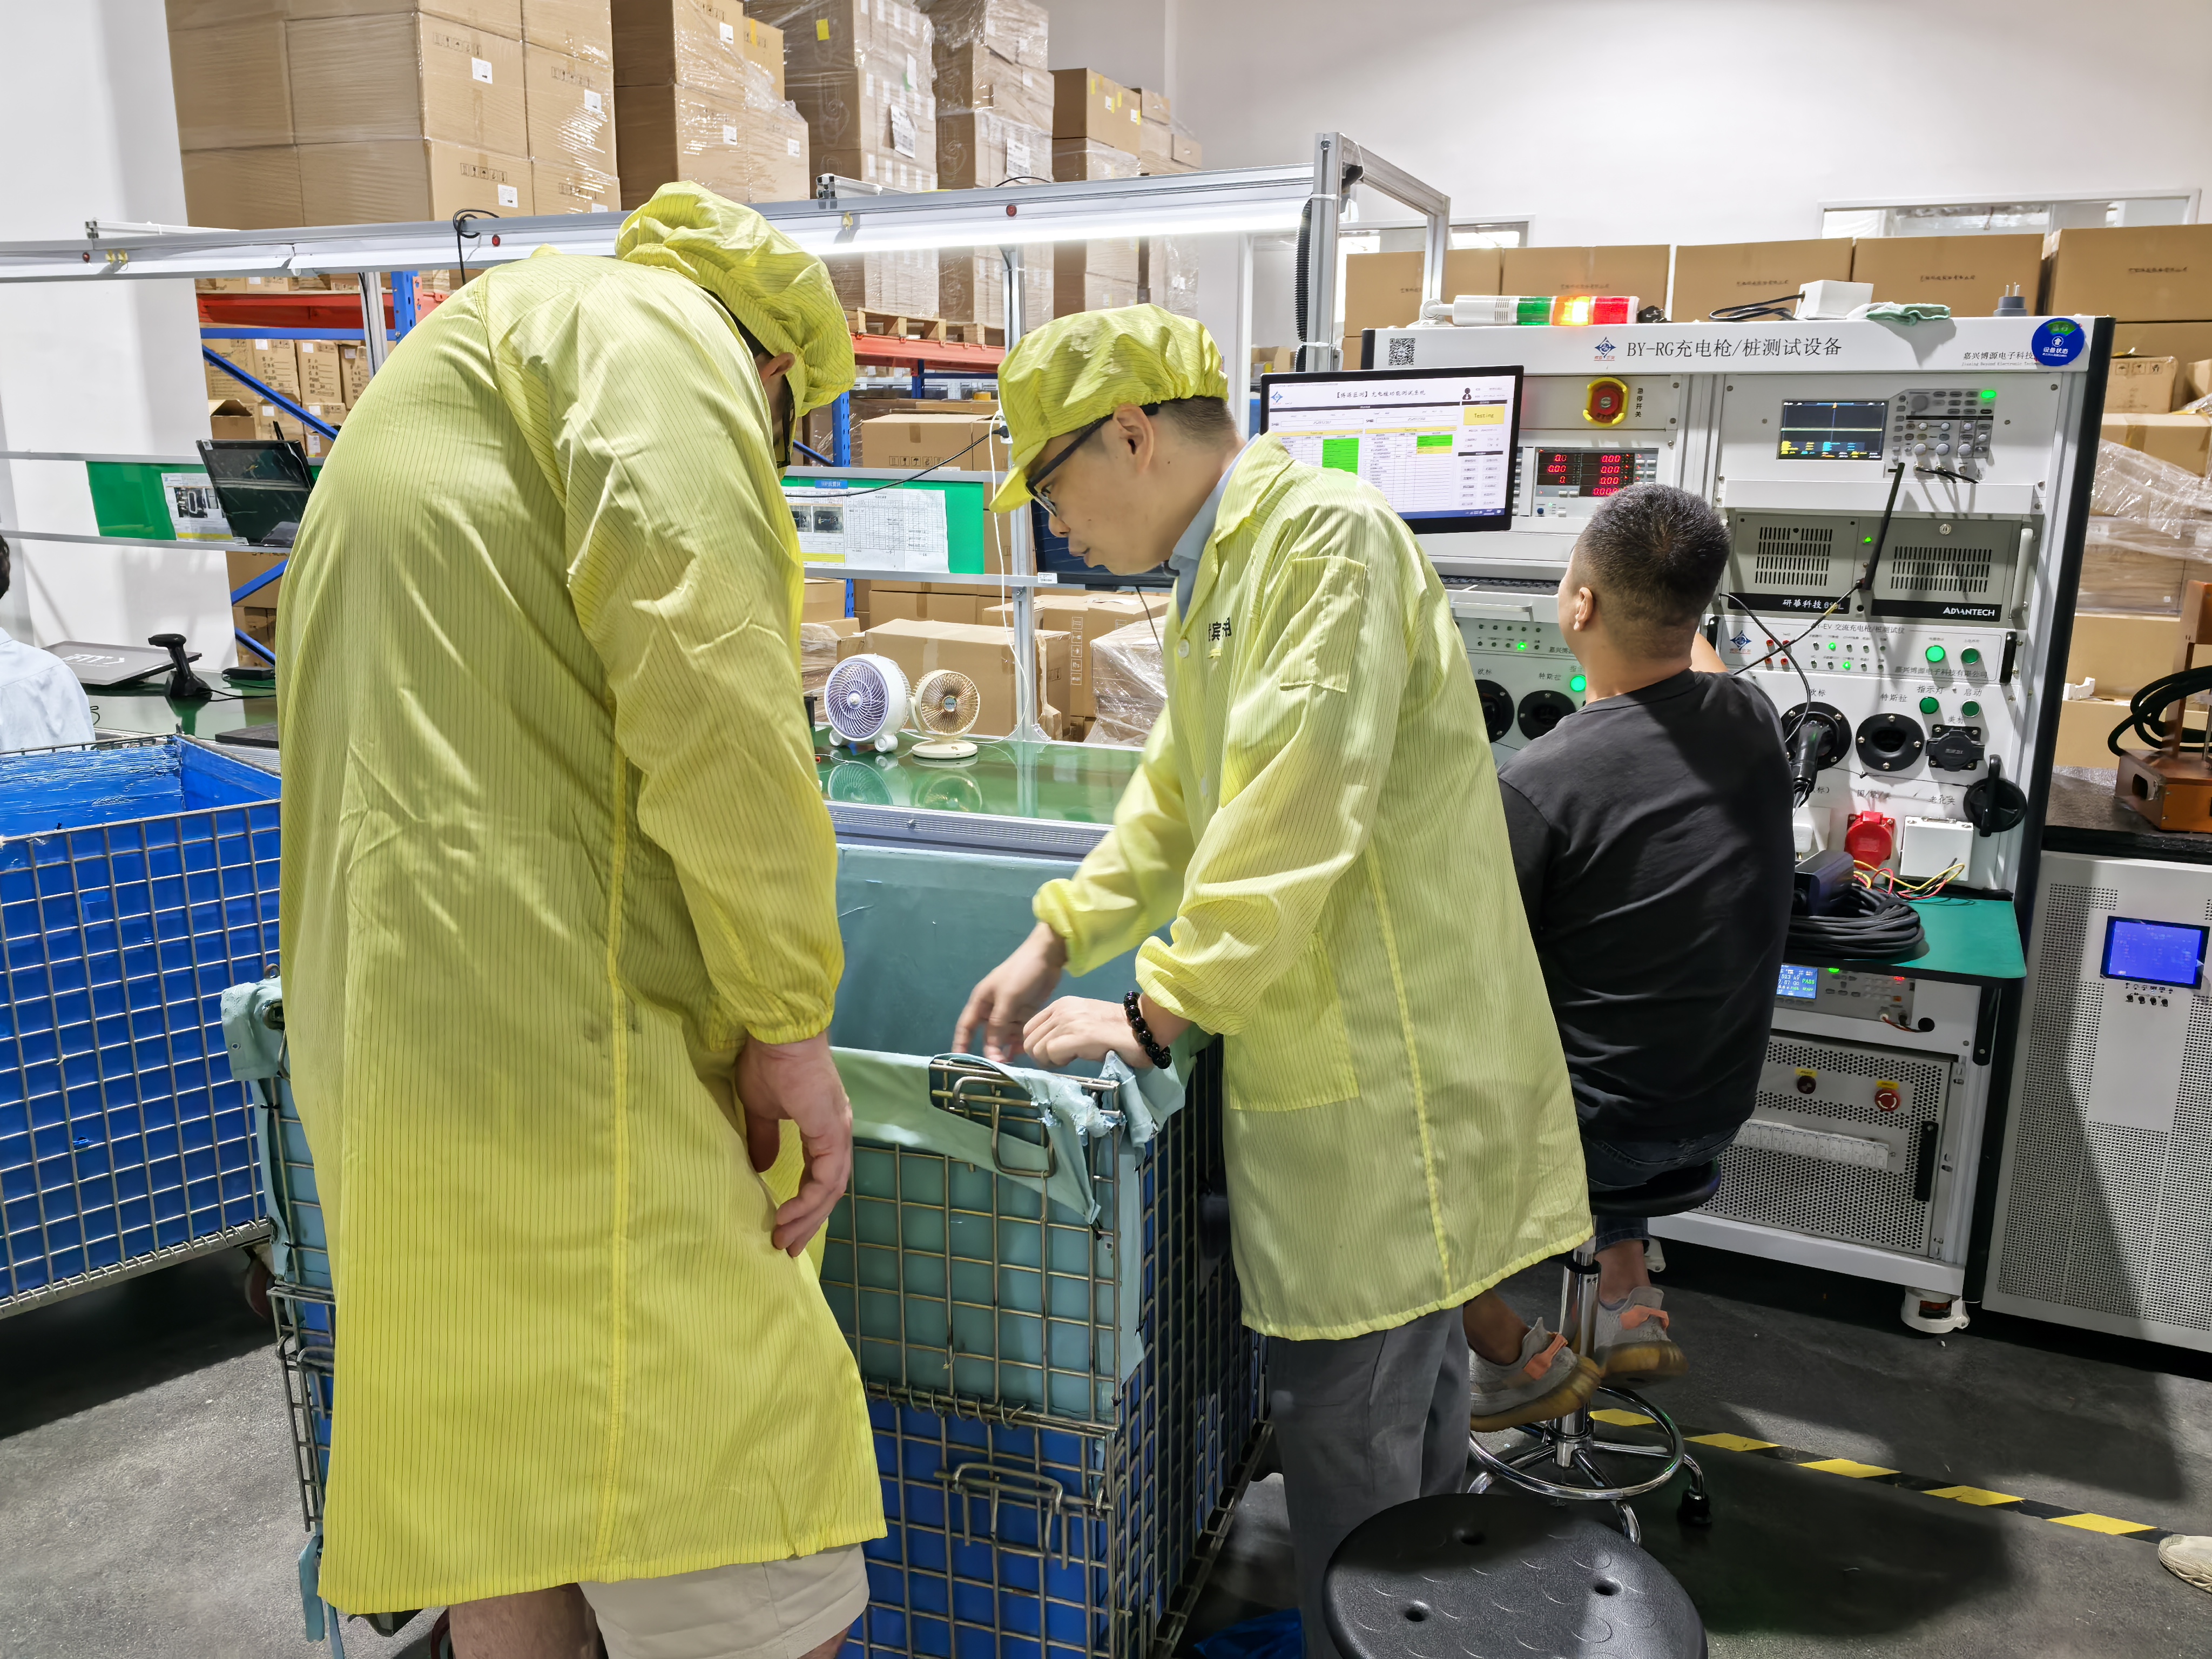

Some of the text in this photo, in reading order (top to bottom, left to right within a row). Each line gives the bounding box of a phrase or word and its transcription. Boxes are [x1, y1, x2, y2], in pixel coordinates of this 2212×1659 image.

[1627, 337, 1842, 358] BY-RG充电枪/桩测试设备
[1635, 388, 1643, 417] 急停开关
[1943, 606, 1995, 616] ADVANTECH
[1539, 672, 1562, 680] 特斯拉
[1917, 685, 1944, 694] 指示灯
[1964, 688, 1982, 697] 启动
[1880, 693, 1907, 703] 特斯拉
